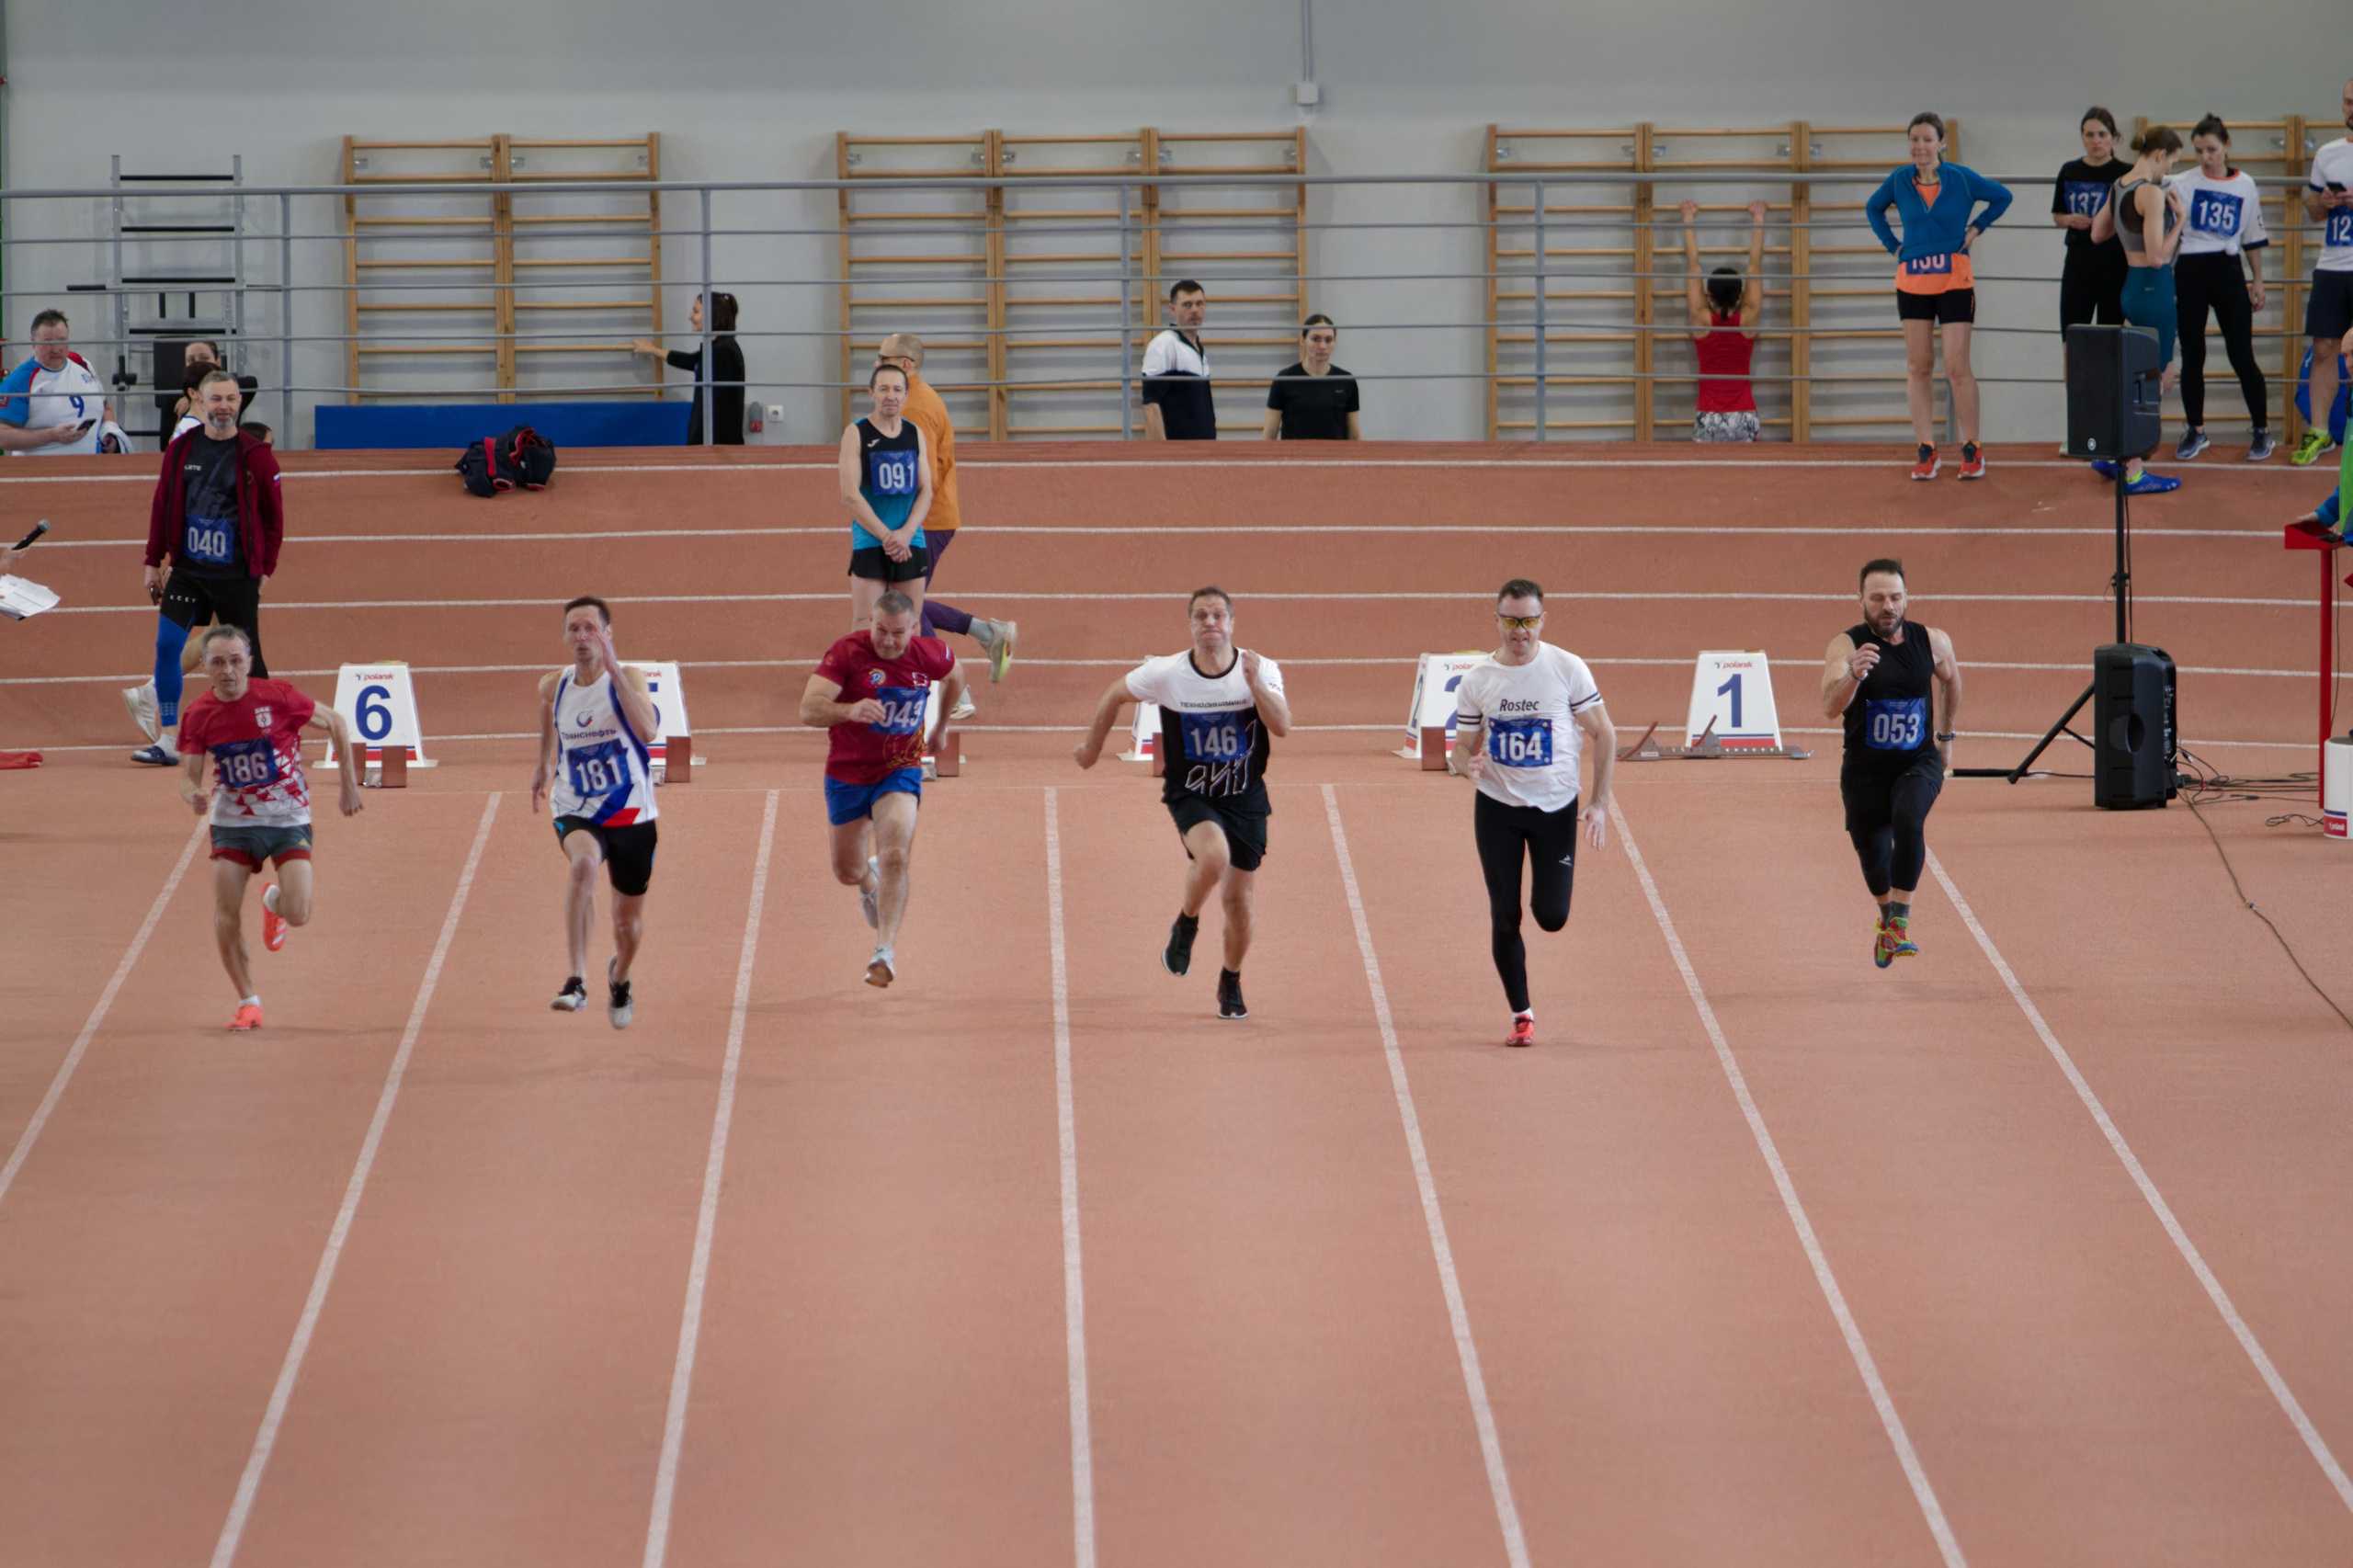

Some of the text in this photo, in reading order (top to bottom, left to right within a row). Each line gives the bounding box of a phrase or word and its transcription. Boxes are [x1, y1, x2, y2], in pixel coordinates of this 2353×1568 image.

[2069, 192, 2102, 217] 137
[2200, 199, 2235, 230] 135
[2332, 215, 2353, 241] 12
[69, 395, 85, 418] 9
[879, 462, 915, 490] 091
[188, 527, 226, 557] 040
[363, 673, 394, 681] polanik
[1452, 663, 1474, 671] pola
[1722, 661, 1753, 669] polanik
[356, 685, 392, 741] 6
[879, 699, 924, 728] 043
[1499, 699, 1540, 711] Rostec
[1717, 674, 1742, 728] 1
[561, 729, 617, 741] Транснефть
[1190, 726, 1237, 757] 146
[1873, 713, 1921, 744] 053
[1497, 731, 1543, 761] 164
[222, 752, 268, 782] 186
[575, 756, 623, 793] 181
